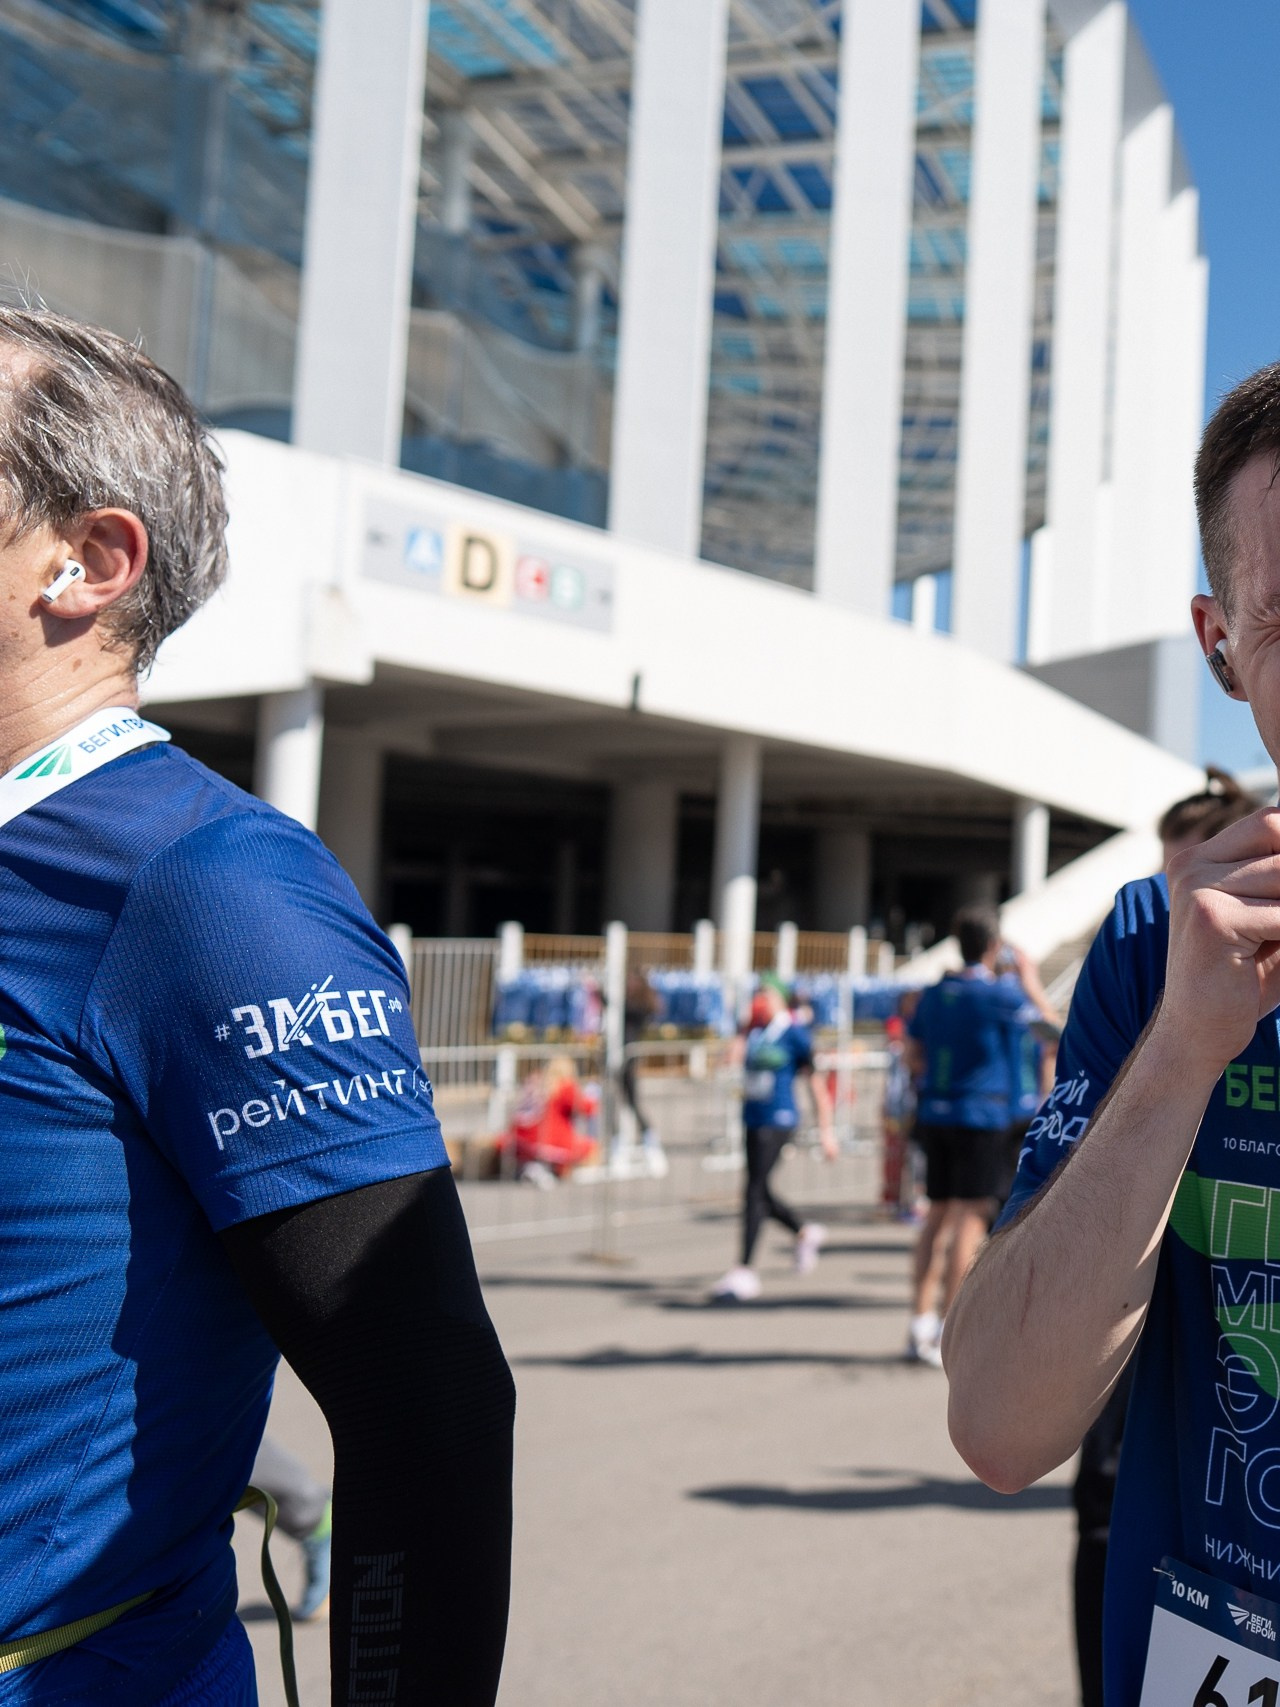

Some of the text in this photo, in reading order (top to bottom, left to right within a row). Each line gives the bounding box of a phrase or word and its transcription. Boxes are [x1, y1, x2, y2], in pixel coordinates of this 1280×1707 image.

[462, 535, 498, 591] D
[1222, 1136, 1238, 1151] 10
[1171, 1580, 1185, 1598] 10
[1245, 1621, 1277, 1642] ГЕРОЙ!
